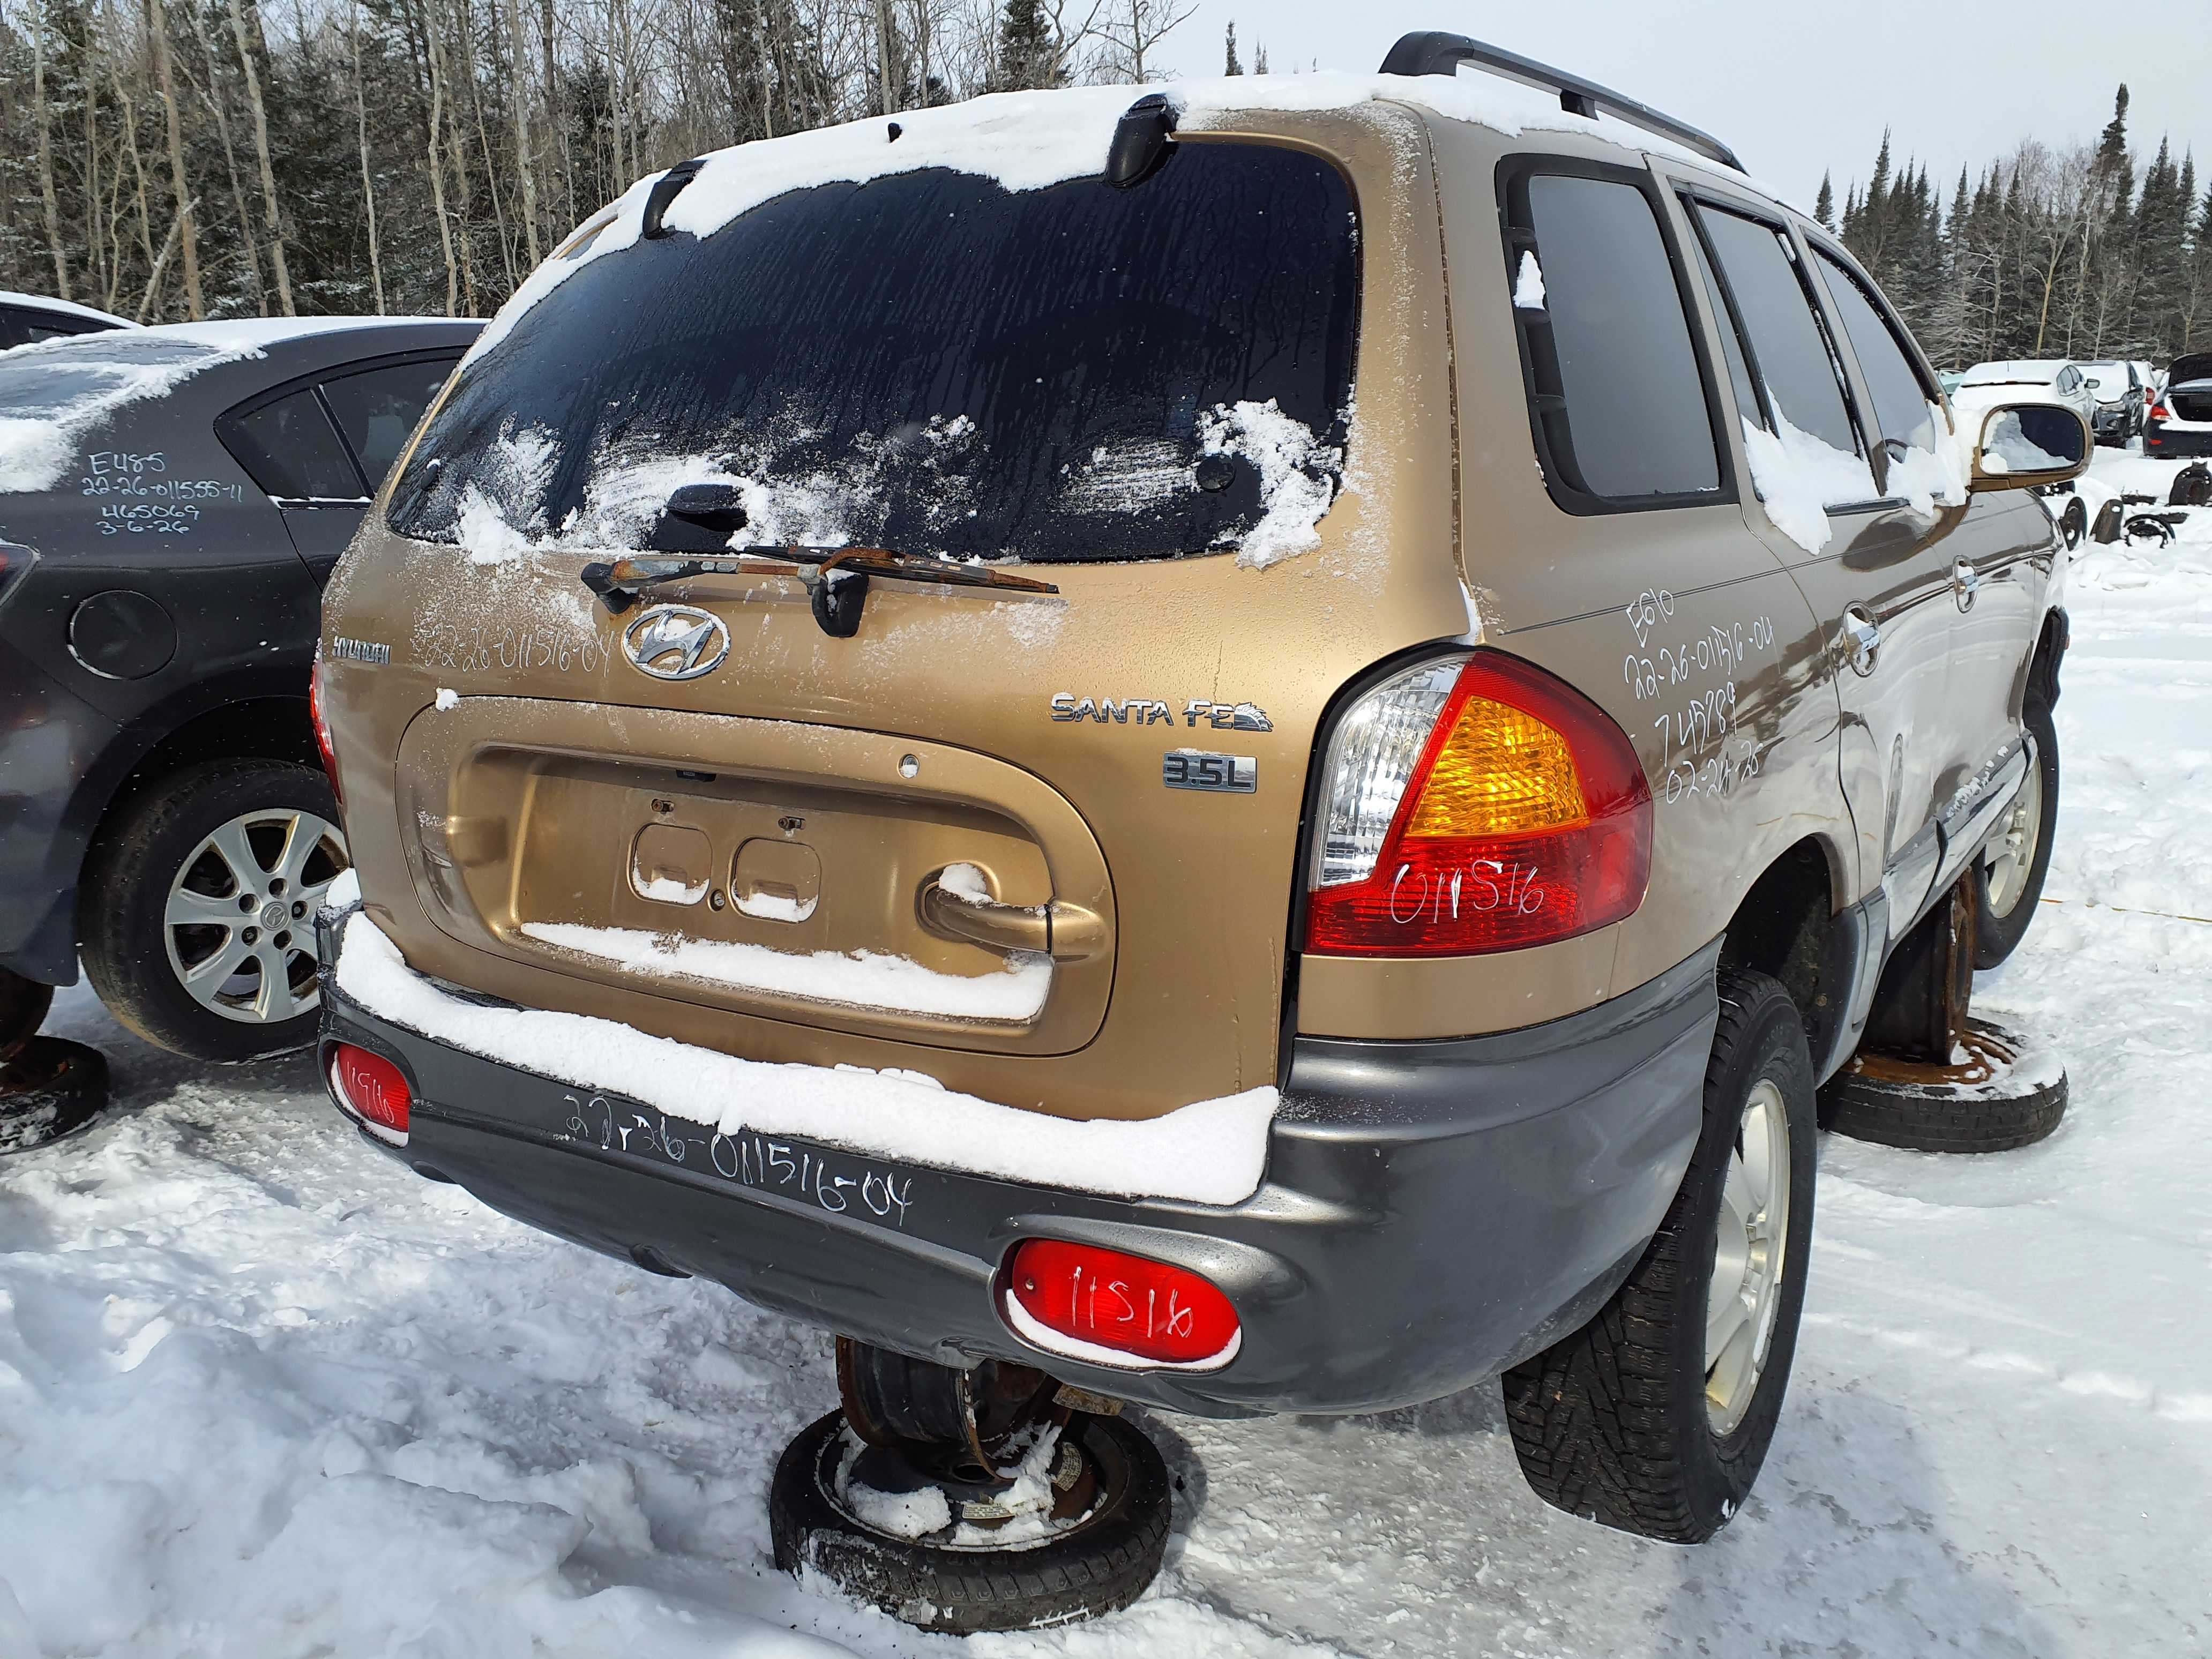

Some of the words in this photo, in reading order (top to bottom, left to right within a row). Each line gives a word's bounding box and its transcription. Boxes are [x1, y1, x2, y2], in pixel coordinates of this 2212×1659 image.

[88, 452, 165, 474] E485
[81, 476, 242, 502] 22-26-011555-11
[101, 505, 199, 520] 465069
[95, 520, 189, 535] 3-6-26
[1626, 587, 1675, 648] E610
[1050, 691, 1174, 726] SANTA
[1182, 699, 1234, 729] FE
[1166, 756, 1252, 789] 3.5L
[1071, 1266, 1193, 1339] 11516
